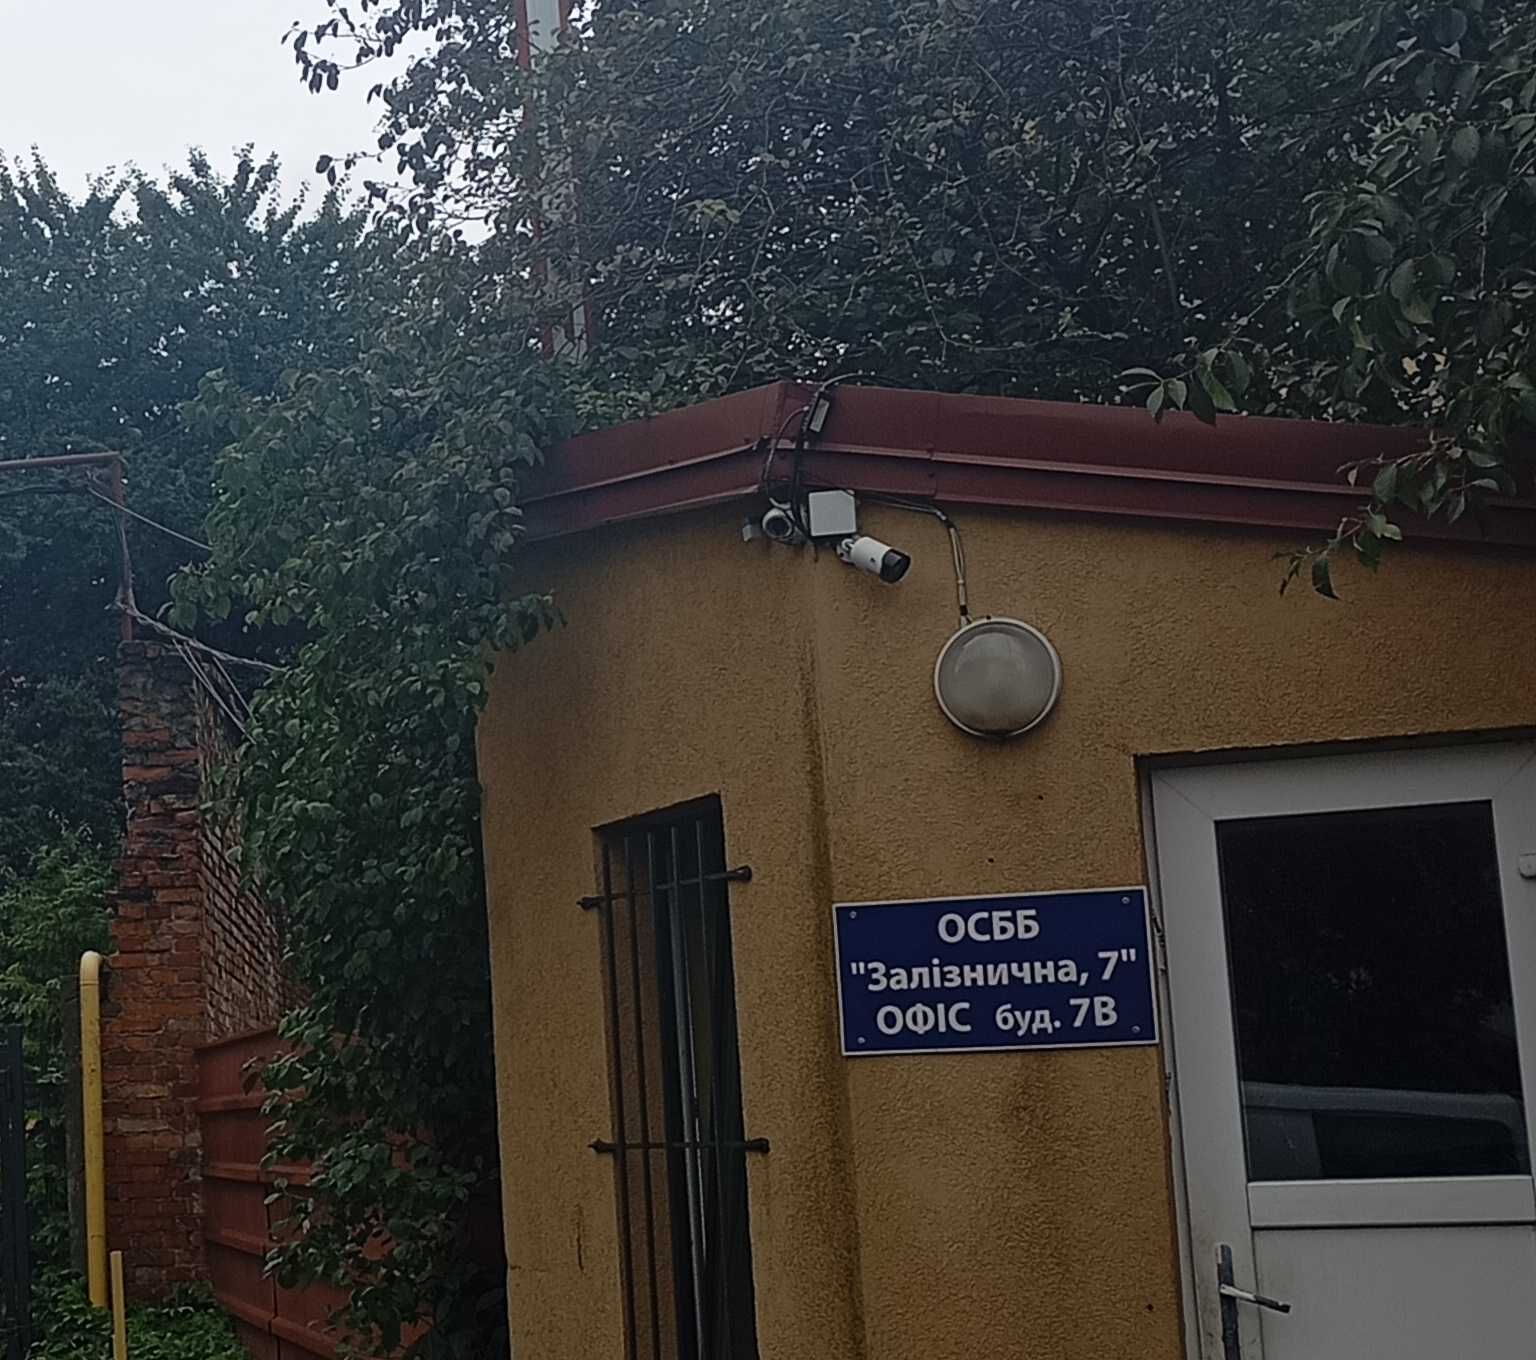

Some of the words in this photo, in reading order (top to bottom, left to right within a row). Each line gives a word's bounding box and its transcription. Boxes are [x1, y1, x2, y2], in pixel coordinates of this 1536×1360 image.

[937, 908, 1041, 943] ОСББ
[850, 957, 1089, 992] "Залізнична,
[1097, 948, 1137, 981] 7"
[876, 1001, 972, 1036] ОФІС
[995, 1003, 1062, 1037] буд.
[1069, 995, 1119, 1028] 7В
